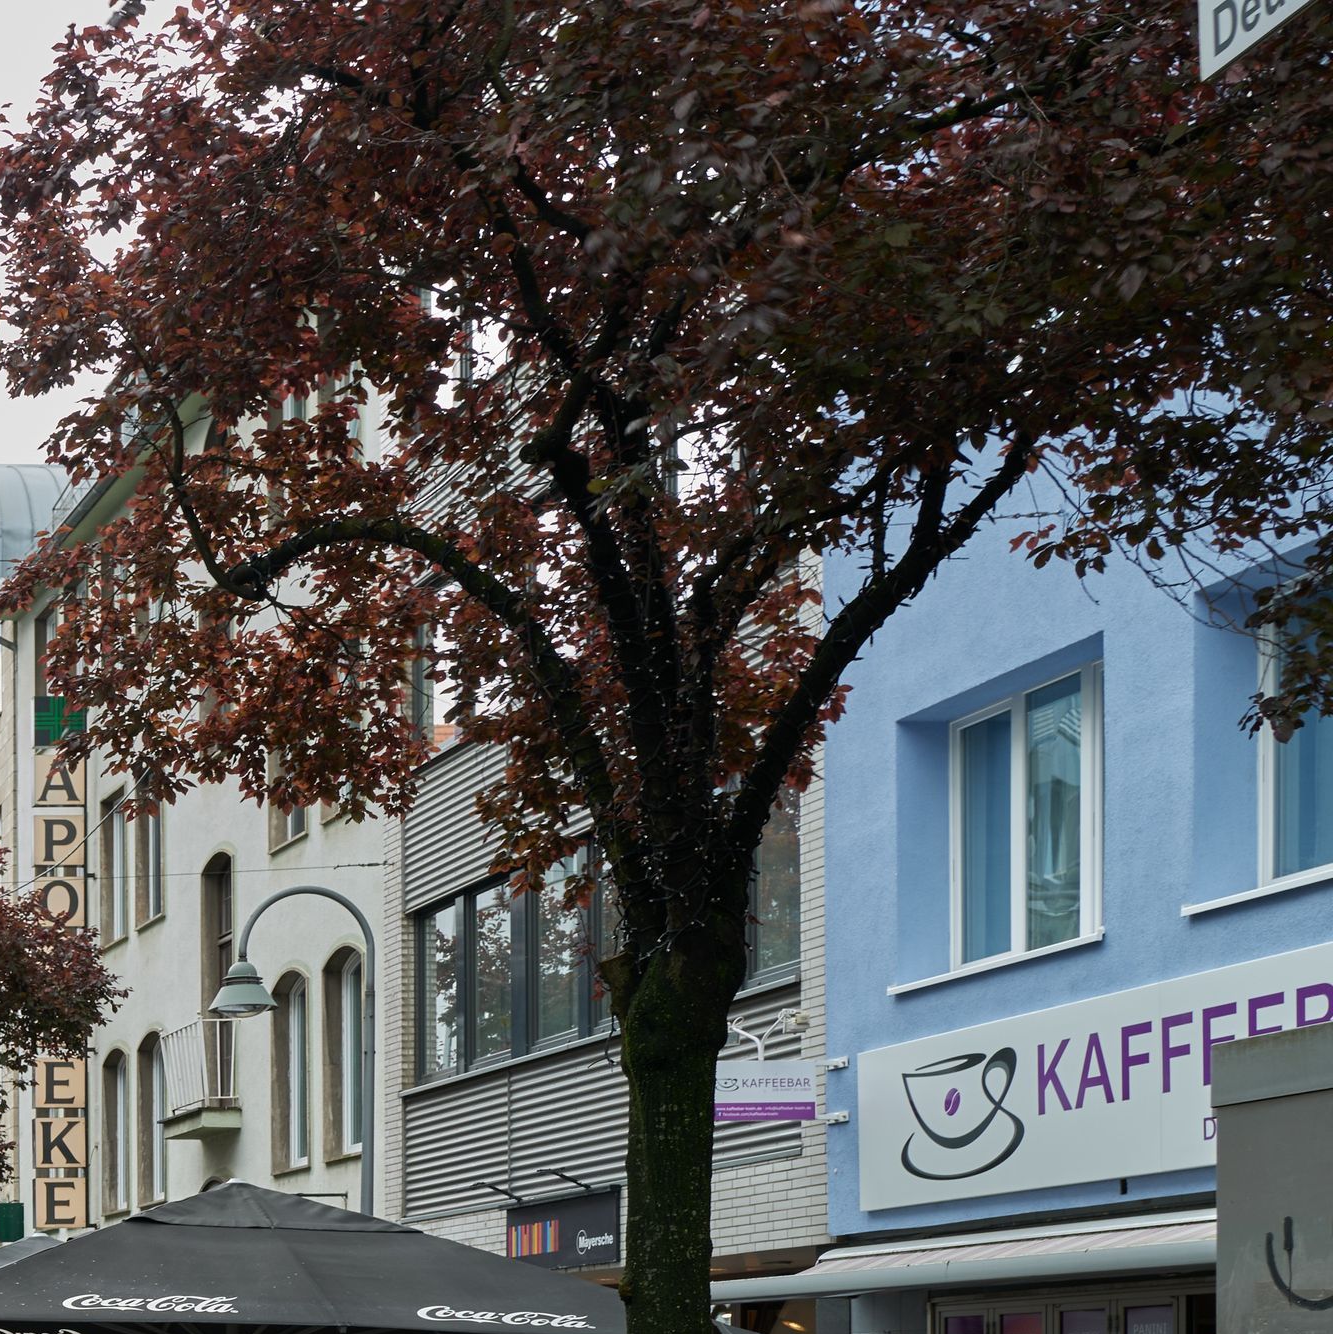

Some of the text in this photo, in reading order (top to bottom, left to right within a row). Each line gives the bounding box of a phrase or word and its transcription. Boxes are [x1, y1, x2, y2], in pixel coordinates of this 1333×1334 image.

[38, 764, 80, 1226] APOEKE
[741, 1078, 812, 1089] KAFFEEBAR
[578, 1232, 614, 1250] Mayersche
[62, 1294, 239, 1314] Coca-Cola
[416, 1305, 596, 1329] Coca-Cola
